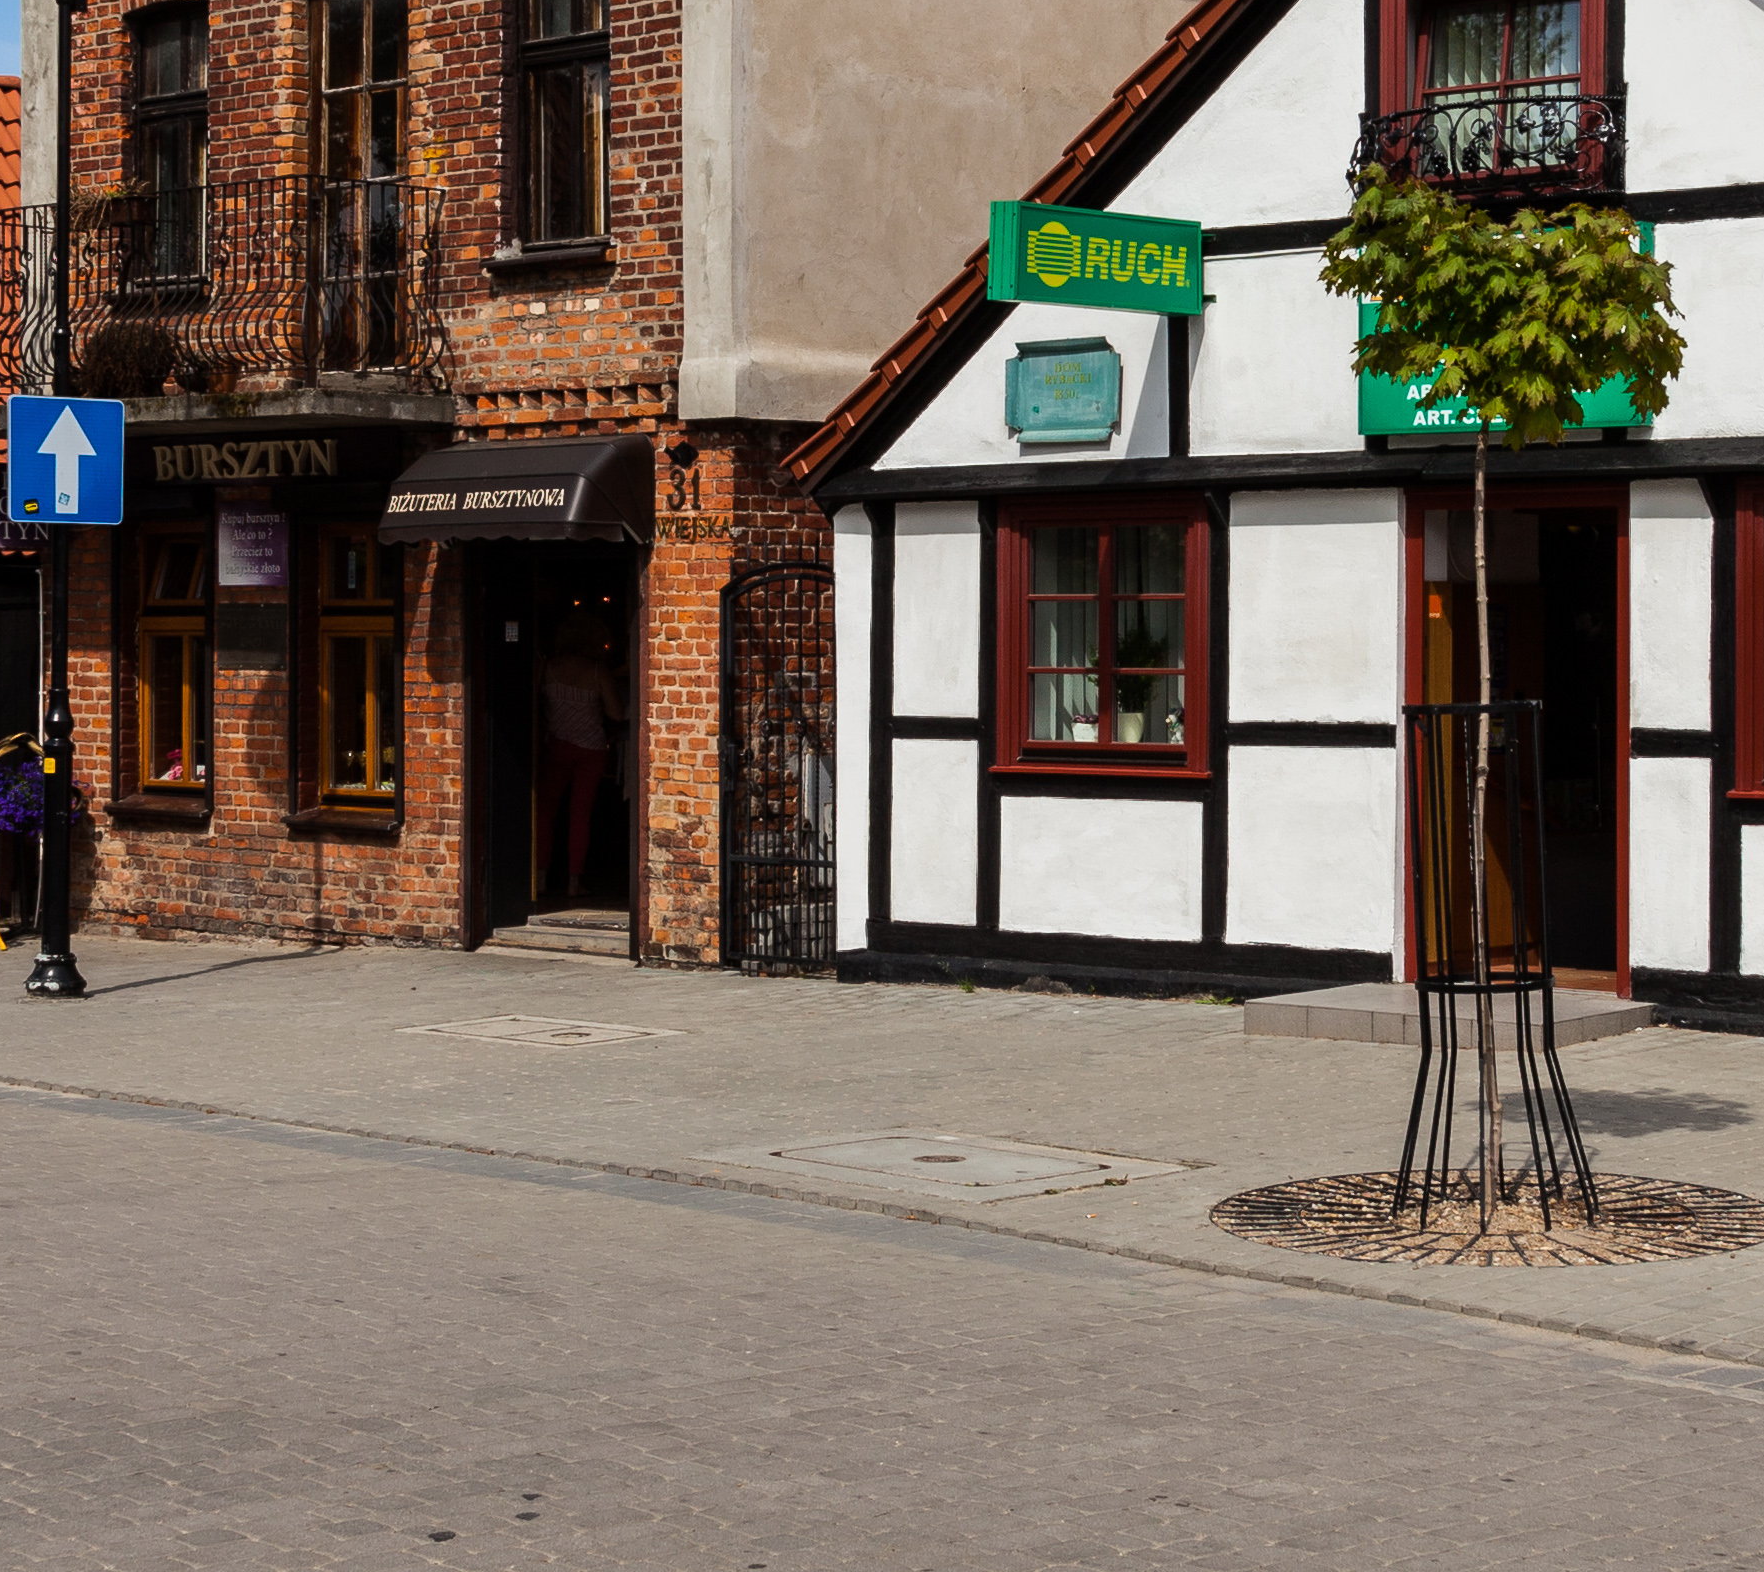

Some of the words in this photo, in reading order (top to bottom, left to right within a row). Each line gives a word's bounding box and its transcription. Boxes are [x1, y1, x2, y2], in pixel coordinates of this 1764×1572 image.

[1085, 236, 1188, 288] RUCH
[1055, 362, 1081, 373] DOM
[1413, 409, 1456, 426] ART.
[152, 439, 337, 481] BURSZTYN
[667, 468, 702, 510] 31
[387, 492, 457, 513] BIŻUTERIA
[462, 488, 565, 510] BURSZTYNOWA
[221, 513, 245, 526] Kupuj
[246, 512, 280, 525] bursztyn
[232, 529, 246, 541] Ale
[247, 532, 256, 540] co
[258, 531, 266, 540] to
[655, 516, 733, 542] WIEJSKA
[231, 545, 263, 558] Przecież
[264, 547, 273, 557] to
[260, 562, 281, 574] złoto
